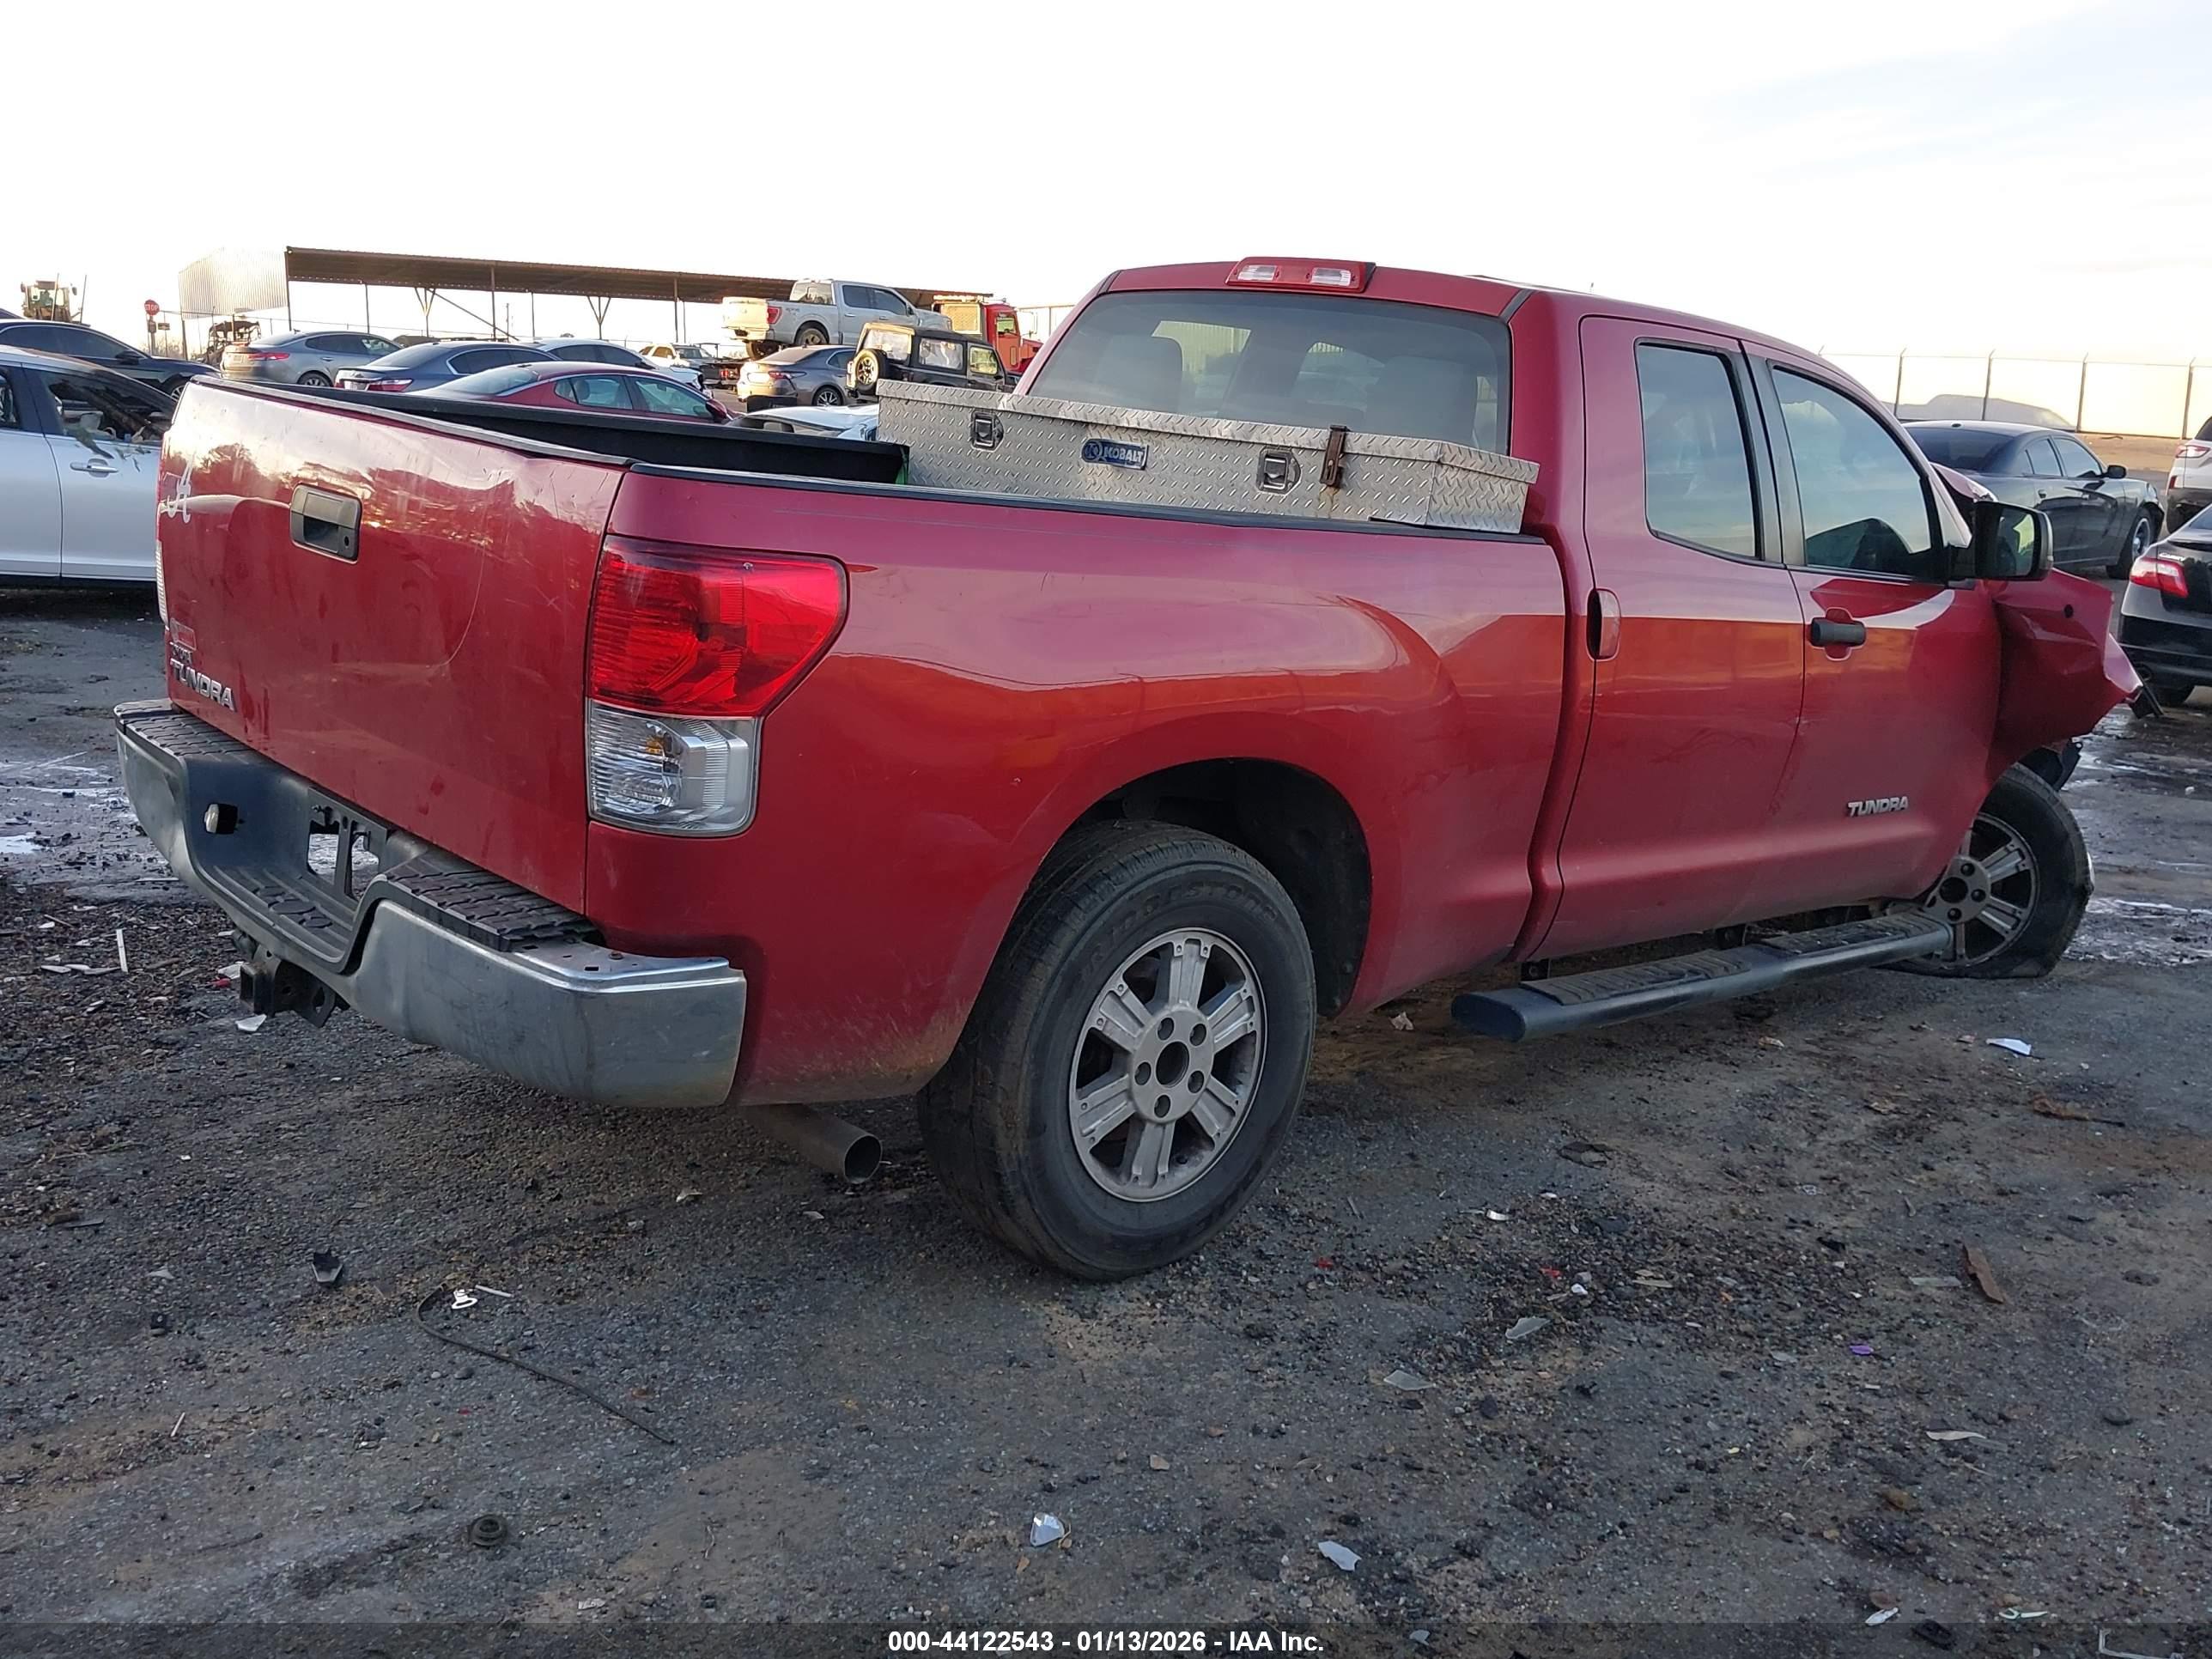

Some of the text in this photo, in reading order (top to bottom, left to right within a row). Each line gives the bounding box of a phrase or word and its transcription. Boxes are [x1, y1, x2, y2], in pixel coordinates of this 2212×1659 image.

[1103, 447, 1144, 463] KOBALT
[170, 658, 236, 712] TUNDRA
[1847, 795, 1909, 817] TUNDRA
